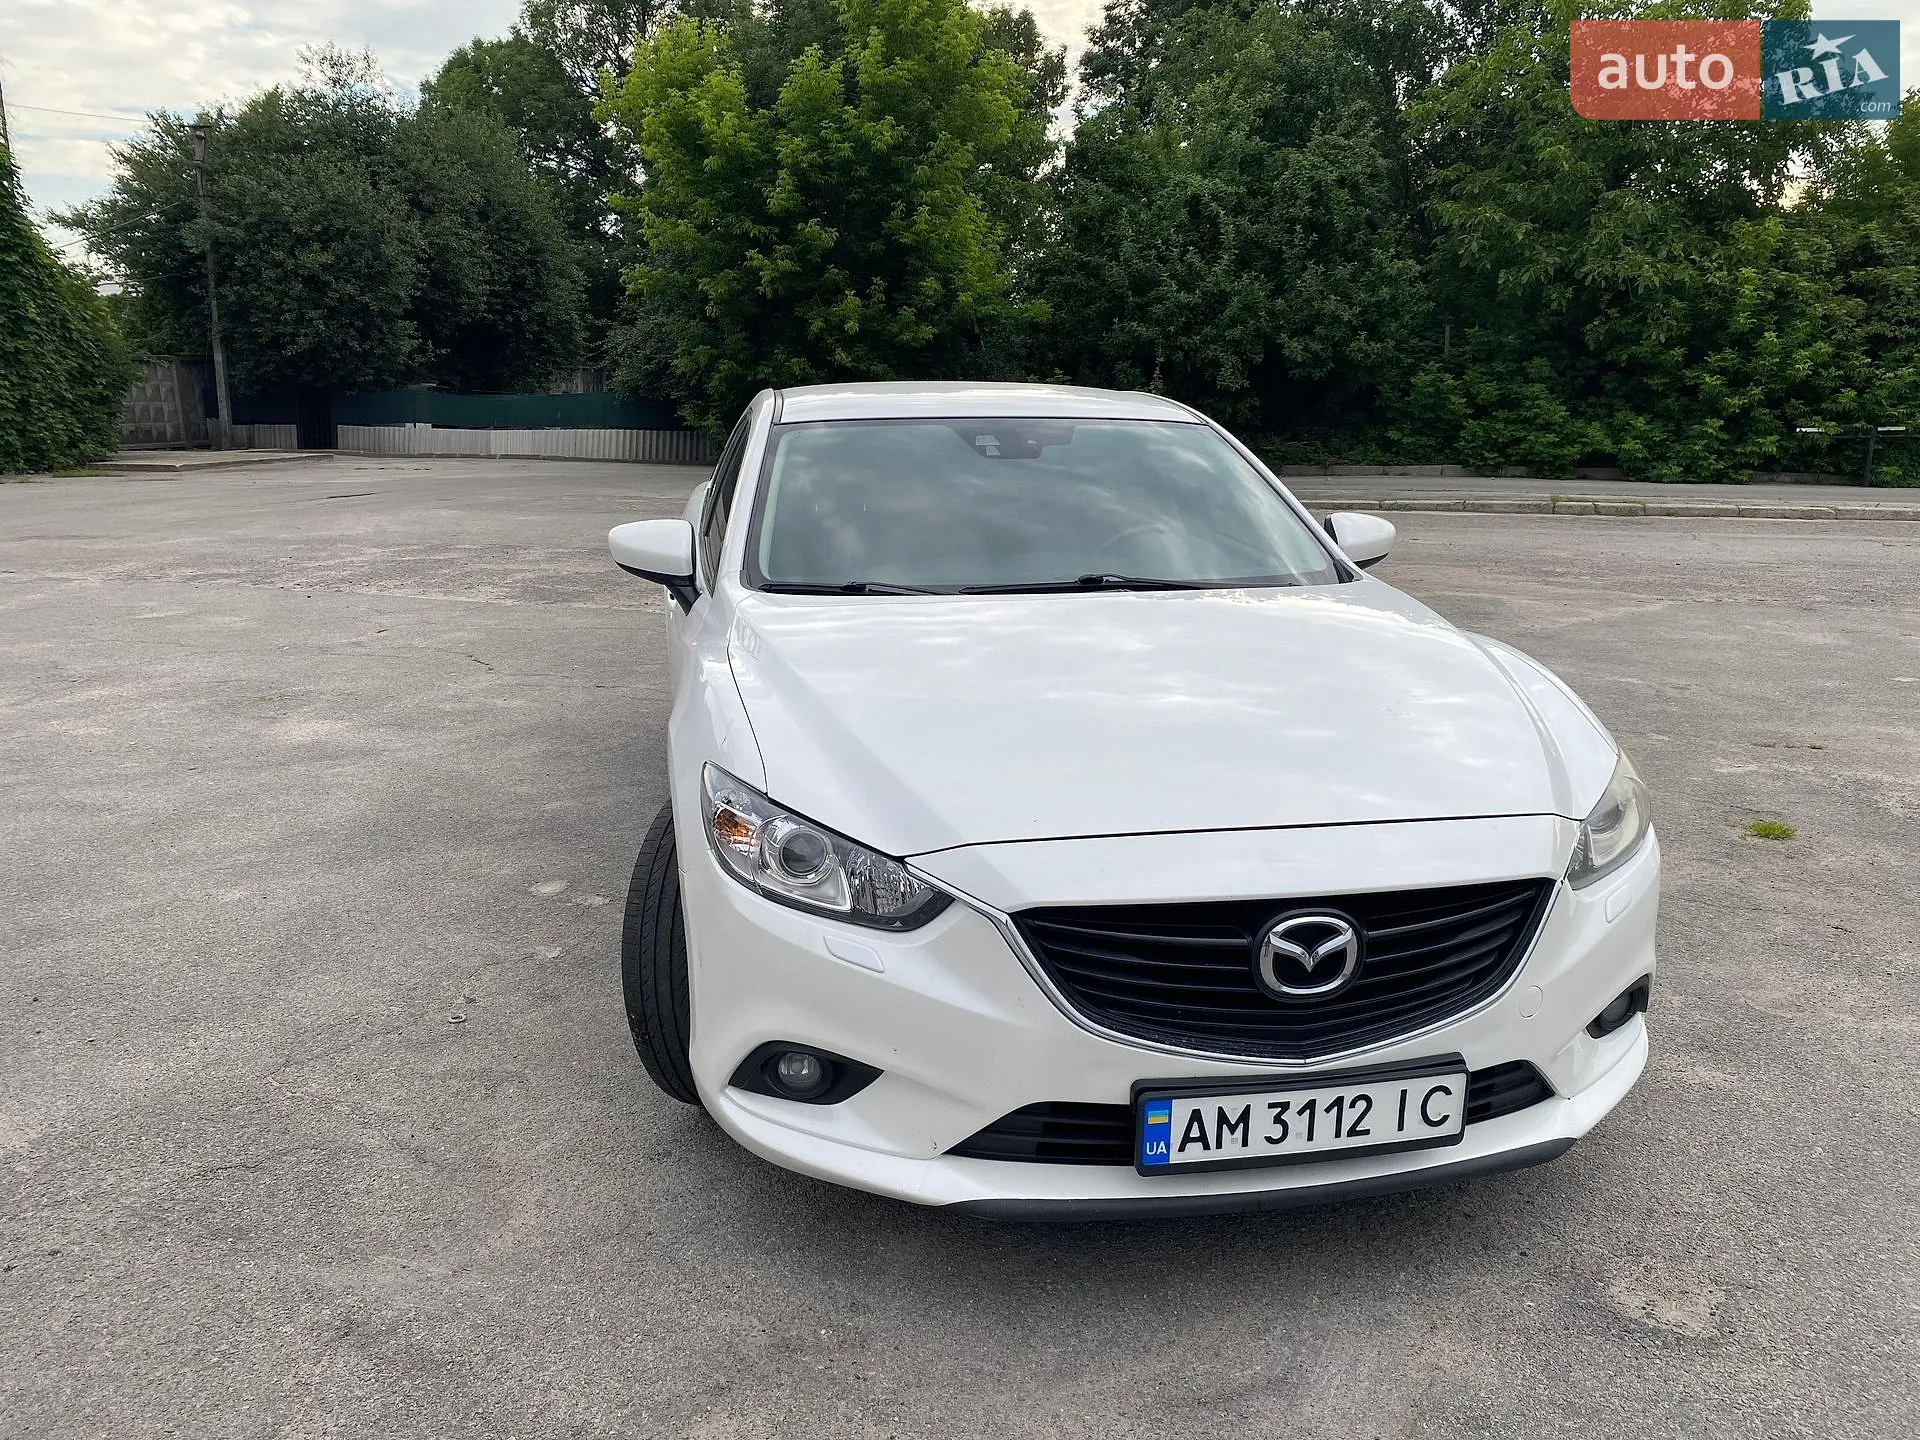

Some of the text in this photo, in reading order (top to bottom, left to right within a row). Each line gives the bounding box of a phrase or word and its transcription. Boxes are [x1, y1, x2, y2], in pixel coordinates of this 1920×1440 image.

[1176, 1103, 1252, 1153] AM
[1263, 1093, 1374, 1145] 3112
[1145, 1140, 1168, 1155] UA
